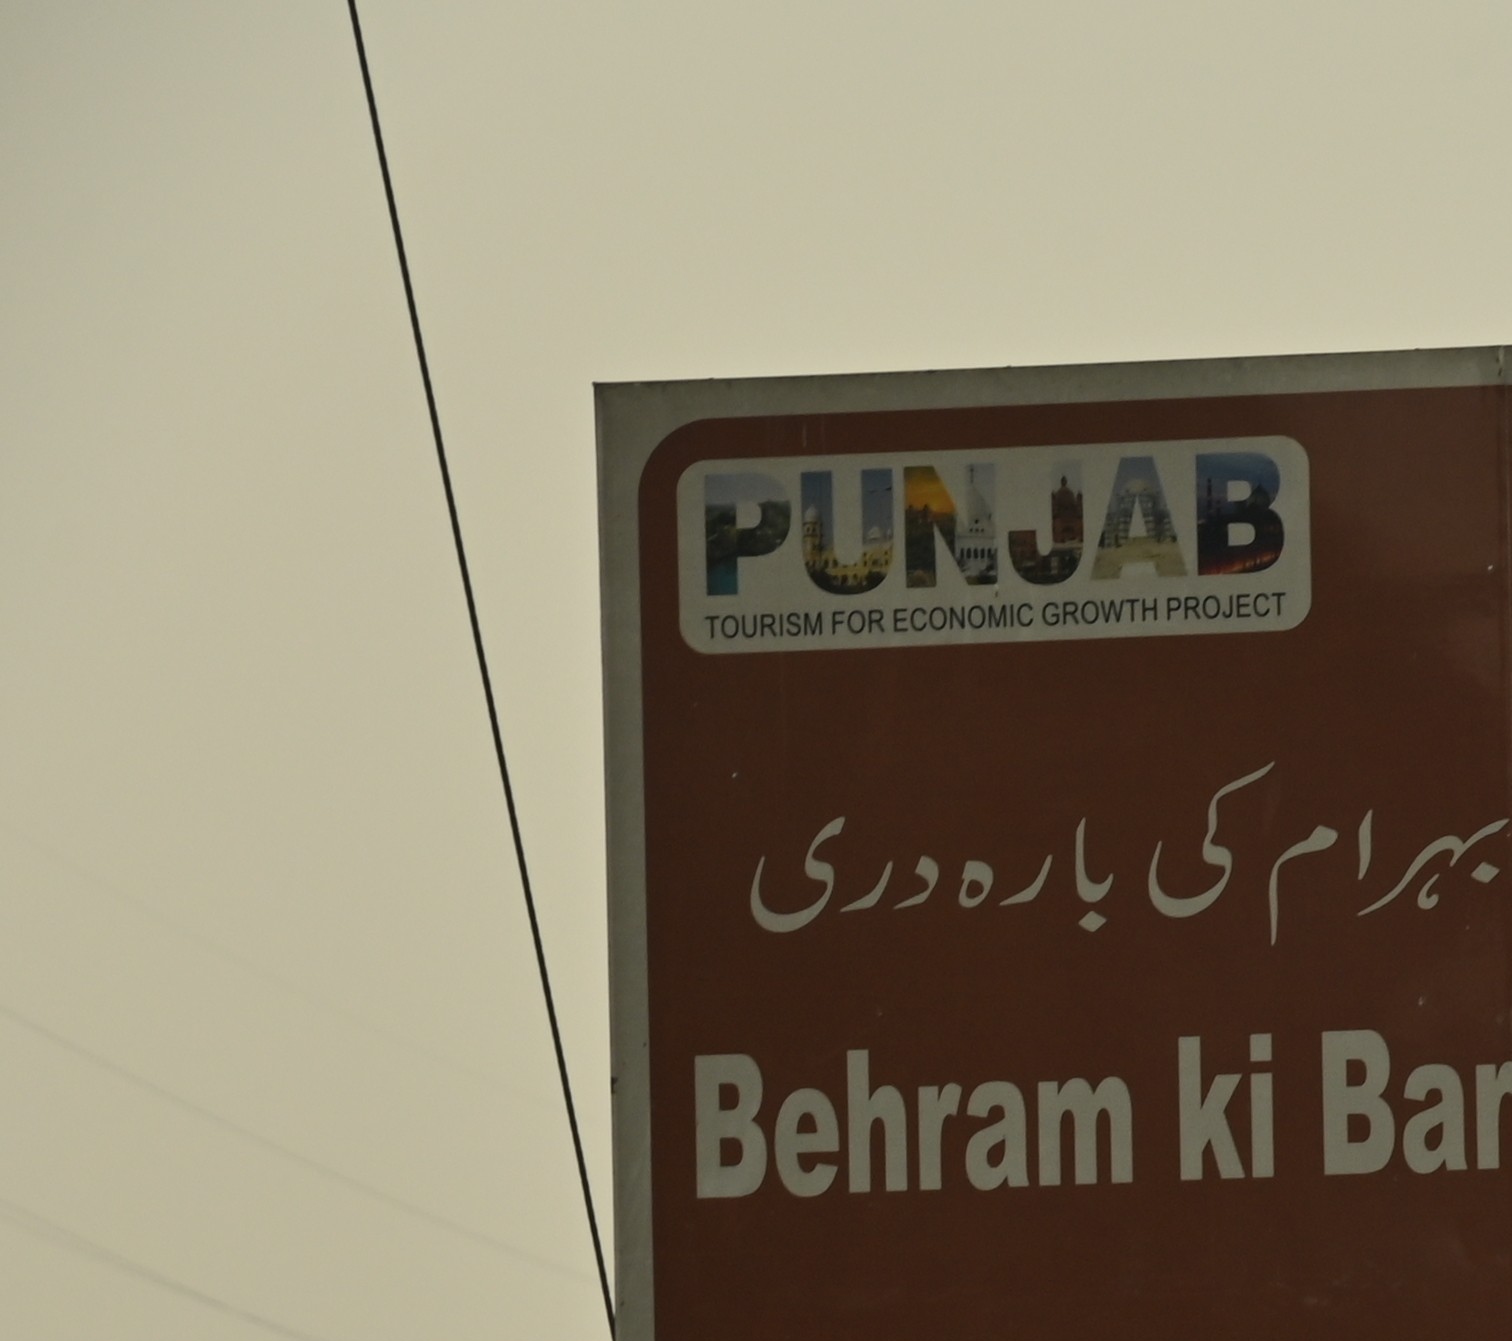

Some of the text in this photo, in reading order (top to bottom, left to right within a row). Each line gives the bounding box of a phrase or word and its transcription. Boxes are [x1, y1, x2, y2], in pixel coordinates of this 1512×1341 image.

[704, 451, 1286, 597] PUNJAB
[705, 592, 1287, 640] TOURISM FOR ECONOMIC GROWTH PROJECT
[750, 816, 940, 933] دری
[1147, 761, 1276, 918] کی
[1268, 807, 1511, 946] بہرام
[694, 1049, 1133, 1199] Behram
[1177, 1033, 1275, 1181] ki
